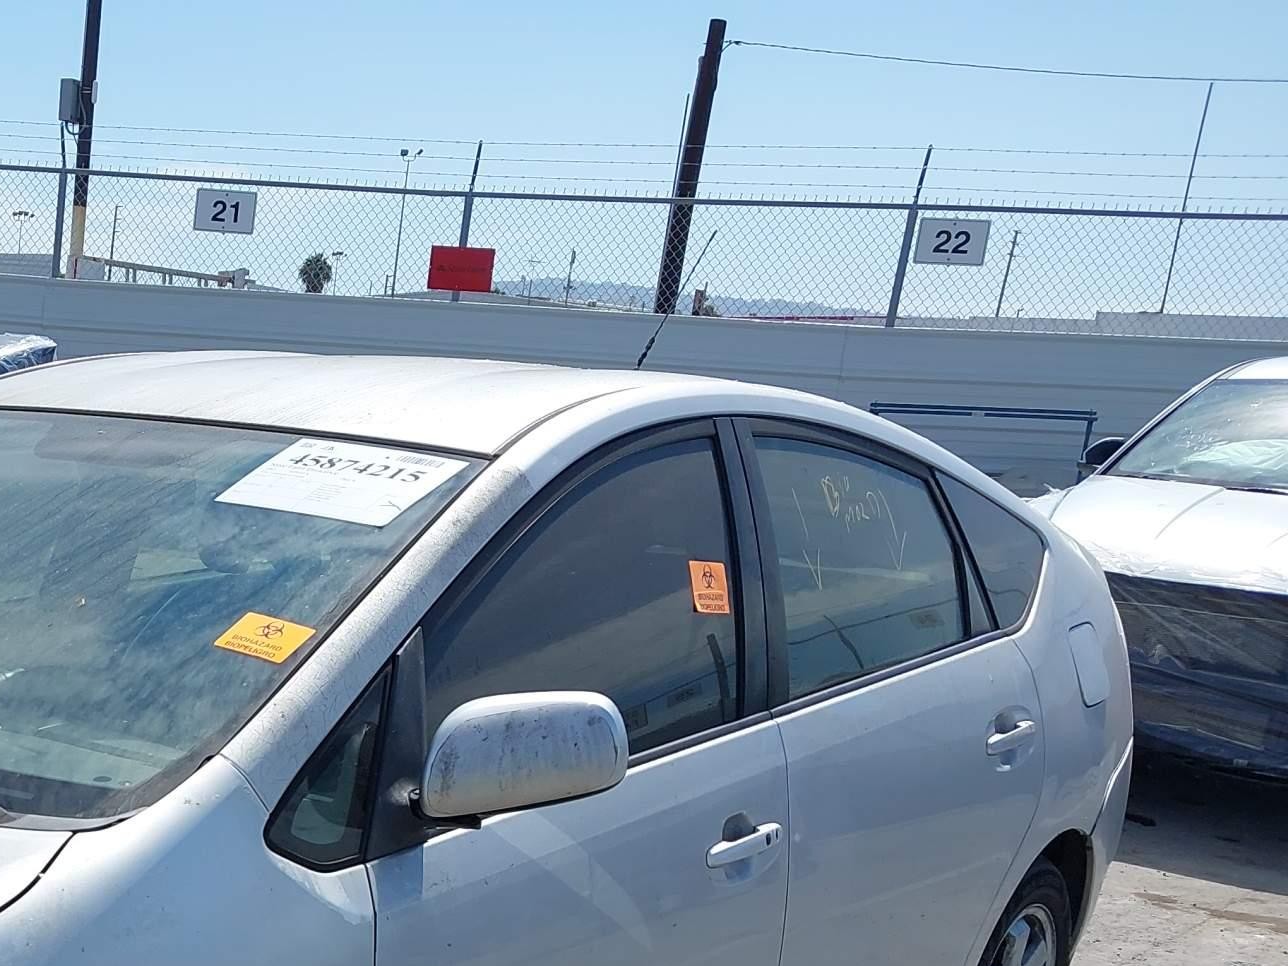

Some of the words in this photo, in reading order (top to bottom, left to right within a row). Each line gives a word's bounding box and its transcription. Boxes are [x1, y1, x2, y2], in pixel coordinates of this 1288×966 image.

[211, 200, 240, 223] 21
[932, 230, 971, 254] 22
[288, 453, 428, 483] 45874215
[224, 640, 276, 659] BIOPELIGRO
[231, 633, 284, 652] BIOHAZARD
